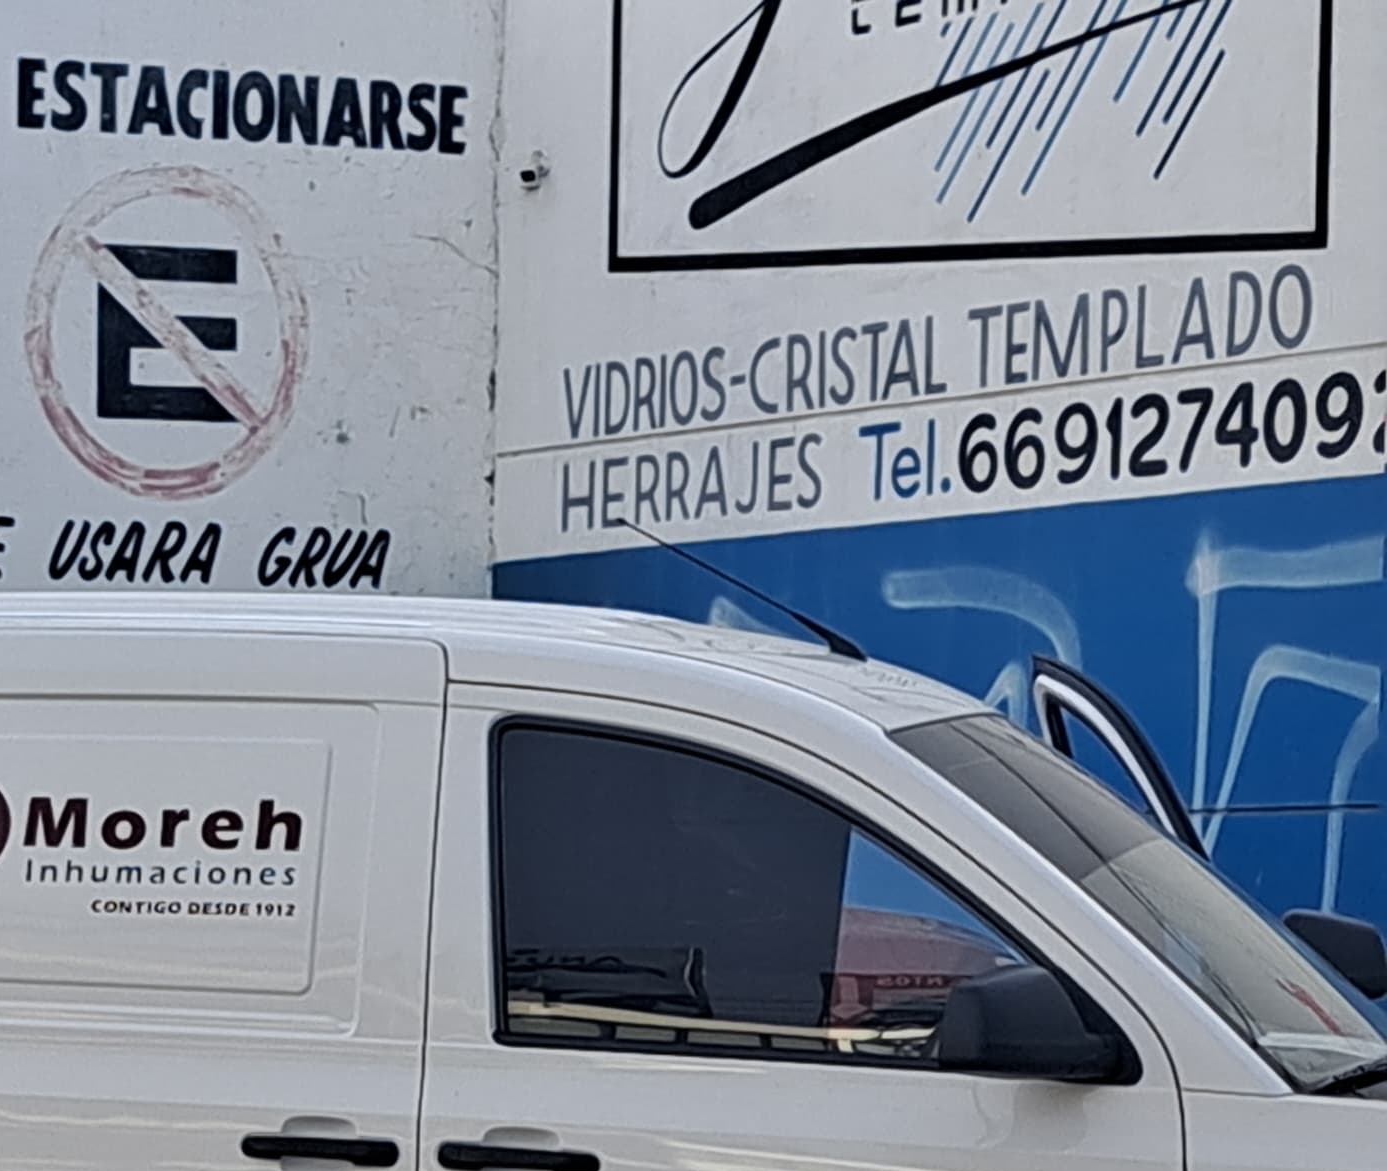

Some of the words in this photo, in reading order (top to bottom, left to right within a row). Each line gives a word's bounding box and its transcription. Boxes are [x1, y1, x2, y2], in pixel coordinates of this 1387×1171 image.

[16, 56, 469, 155] ESTACIONARSE
[563, 315, 948, 440] VIDRIOS-CRISTAL
[968, 263, 1313, 389] TEMPLADO
[561, 433, 824, 533] HERRAJES
[48, 519, 223, 584] USARA
[256, 525, 393, 590] GRUA
[23, 797, 304, 852] Moreh
[25, 859, 296, 886] Inhumaciones
[90, 899, 183, 915] CONTIGO
[188, 902, 251, 917] DESDE
[256, 902, 297, 917] 1912
